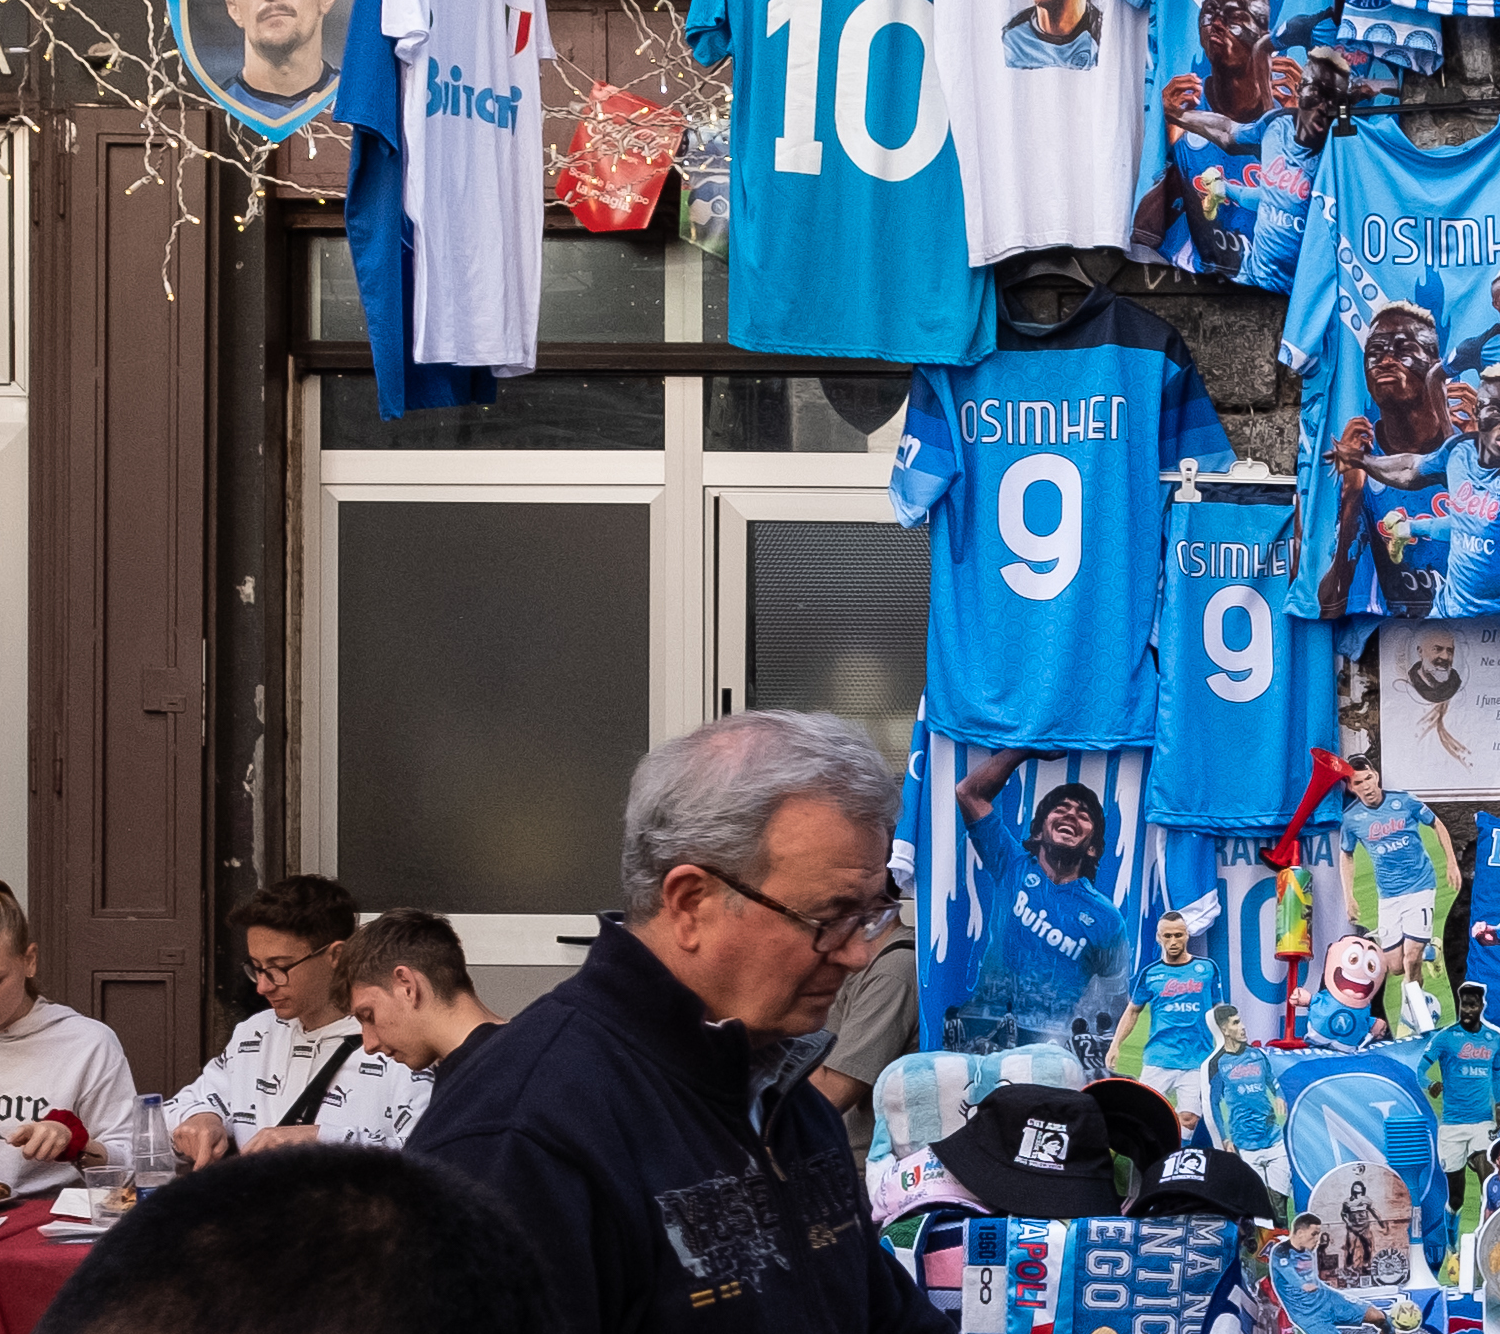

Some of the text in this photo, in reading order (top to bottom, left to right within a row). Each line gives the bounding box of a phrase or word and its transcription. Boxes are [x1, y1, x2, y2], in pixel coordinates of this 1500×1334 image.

[960, 394, 1129, 447] OSIMHEN
[997, 452, 1083, 601] 9
[1202, 583, 1273, 704] 9
[1480, 656, 1496, 667] Ne
[1481, 628, 1496, 644] DI
[1012, 889, 1088, 961] Buitoni
